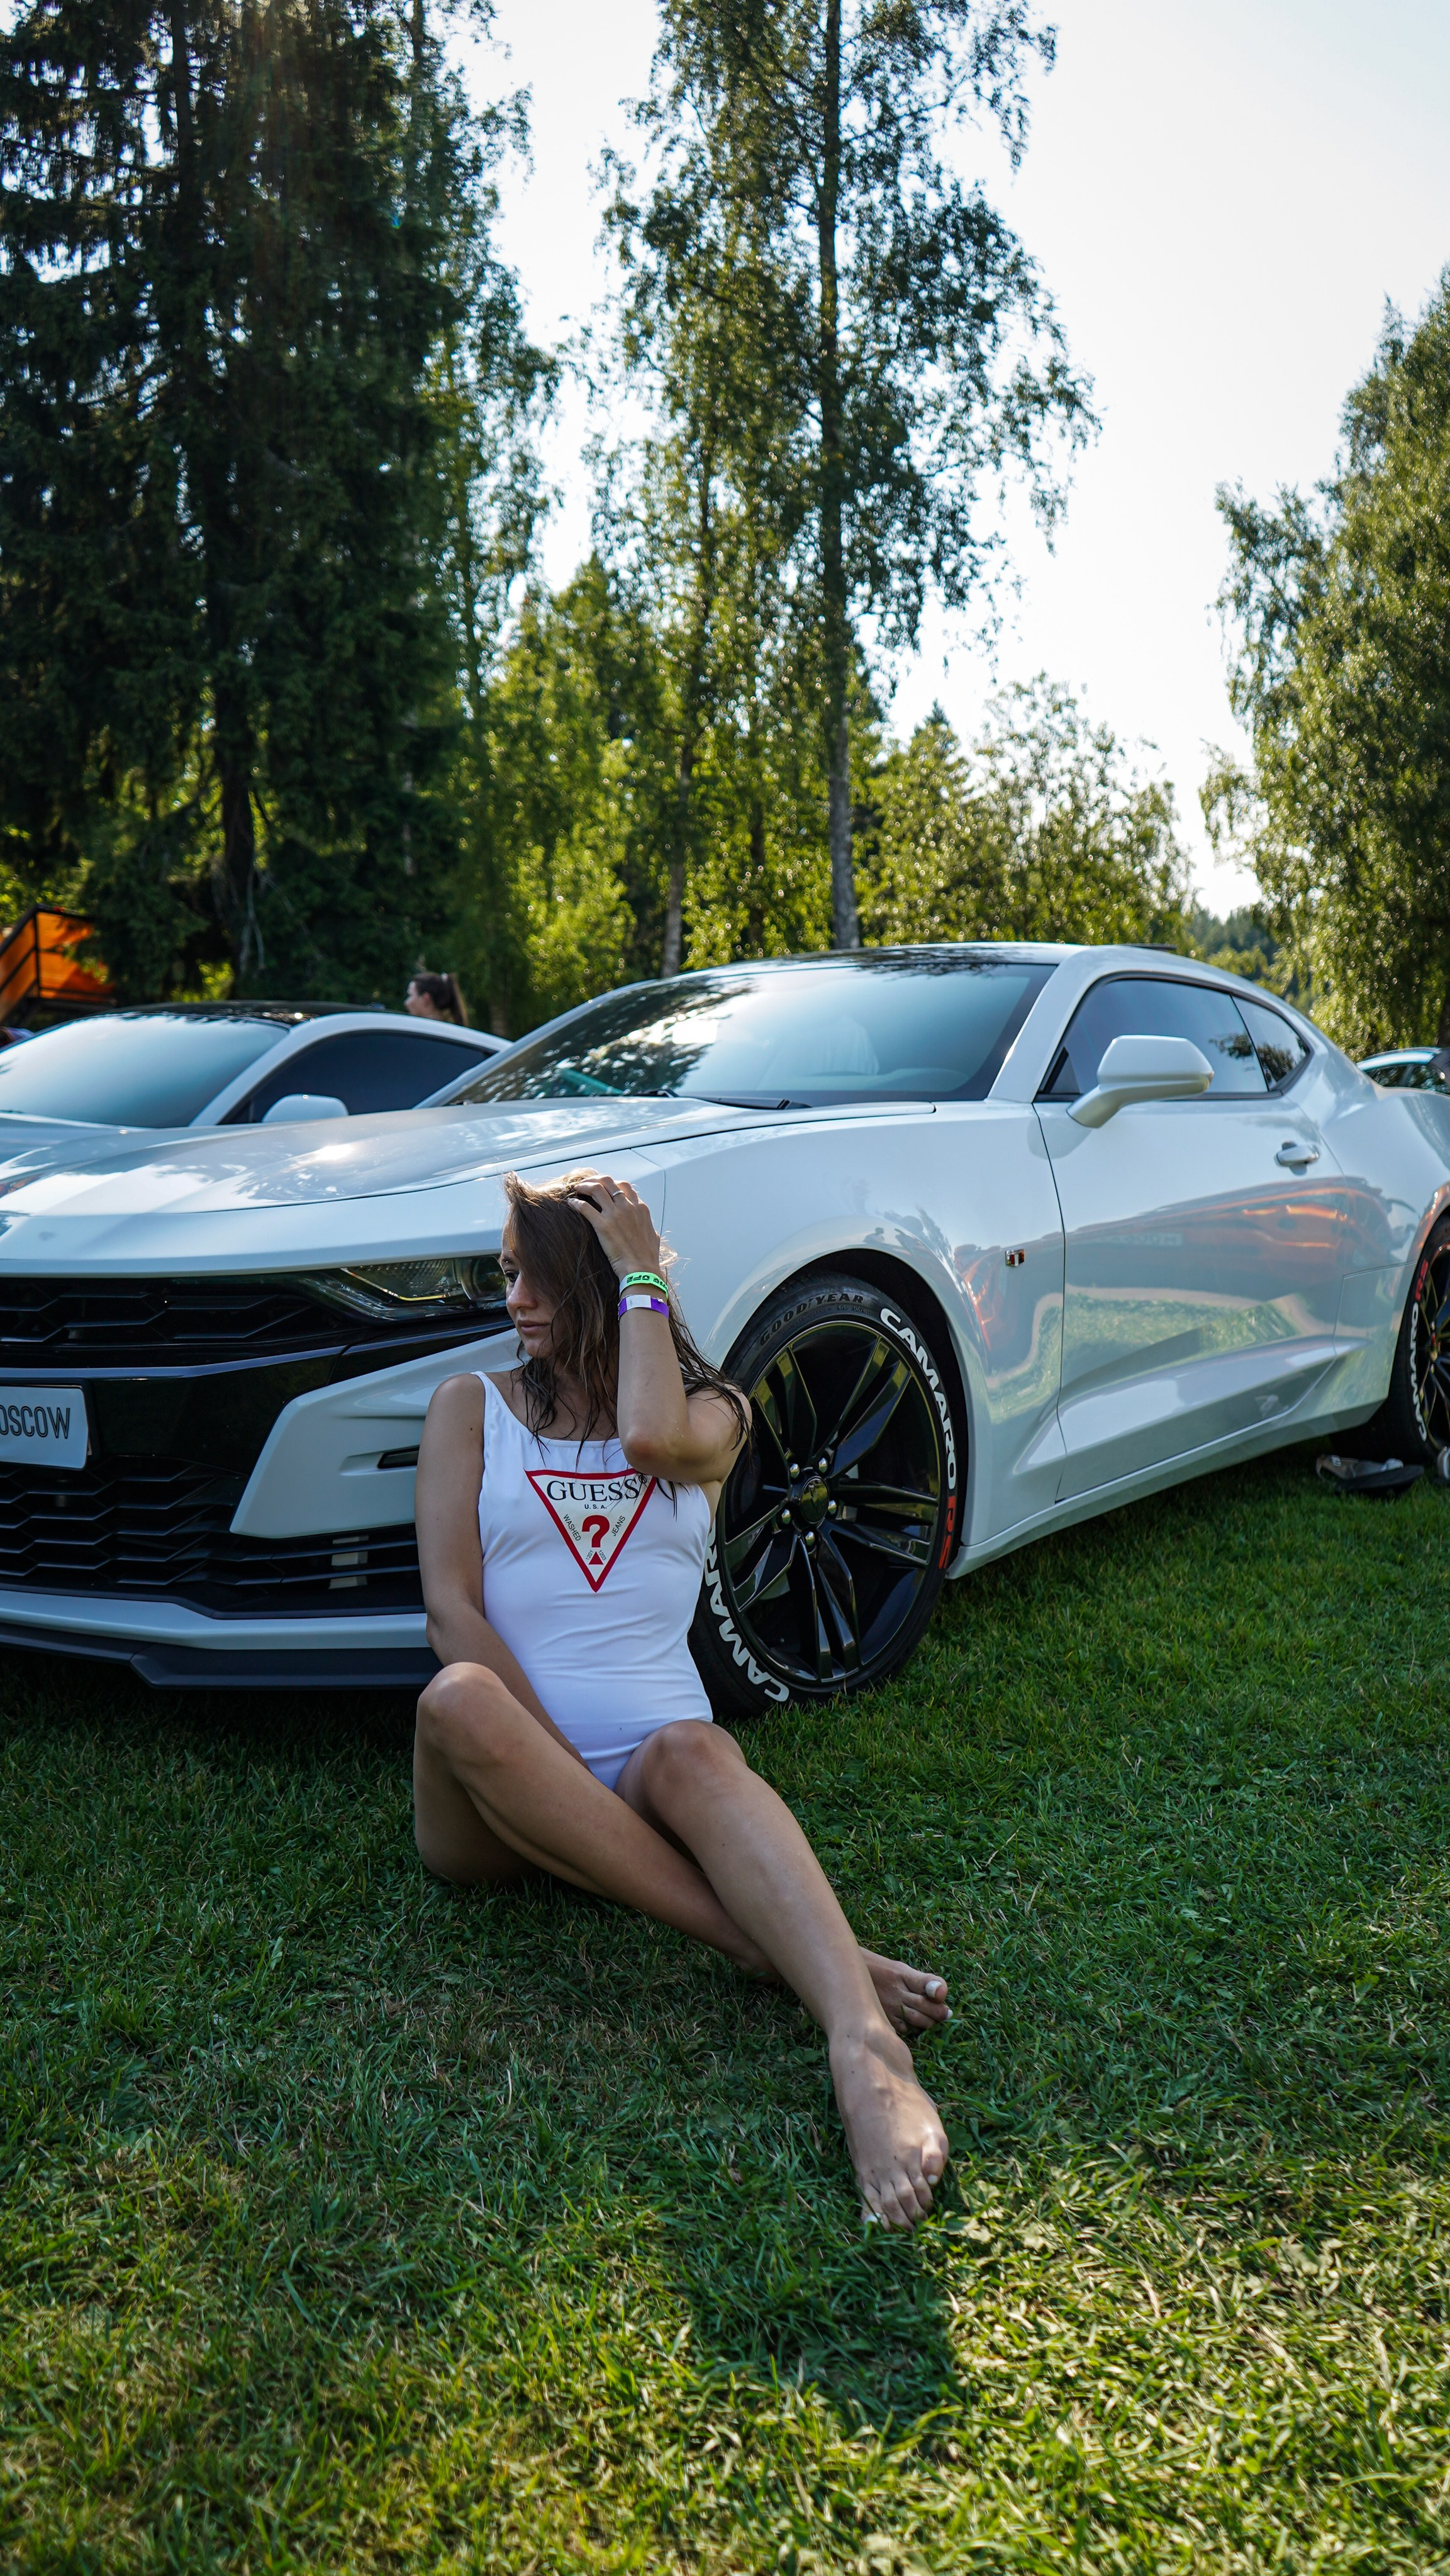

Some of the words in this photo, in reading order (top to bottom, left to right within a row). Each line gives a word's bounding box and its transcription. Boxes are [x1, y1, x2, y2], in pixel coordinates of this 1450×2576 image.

[880, 1308, 956, 1489] CAMARO
[939, 1496, 956, 1570] RS
[563, 1514, 581, 1541] WASHED
[611, 1515, 626, 1537] JEANS
